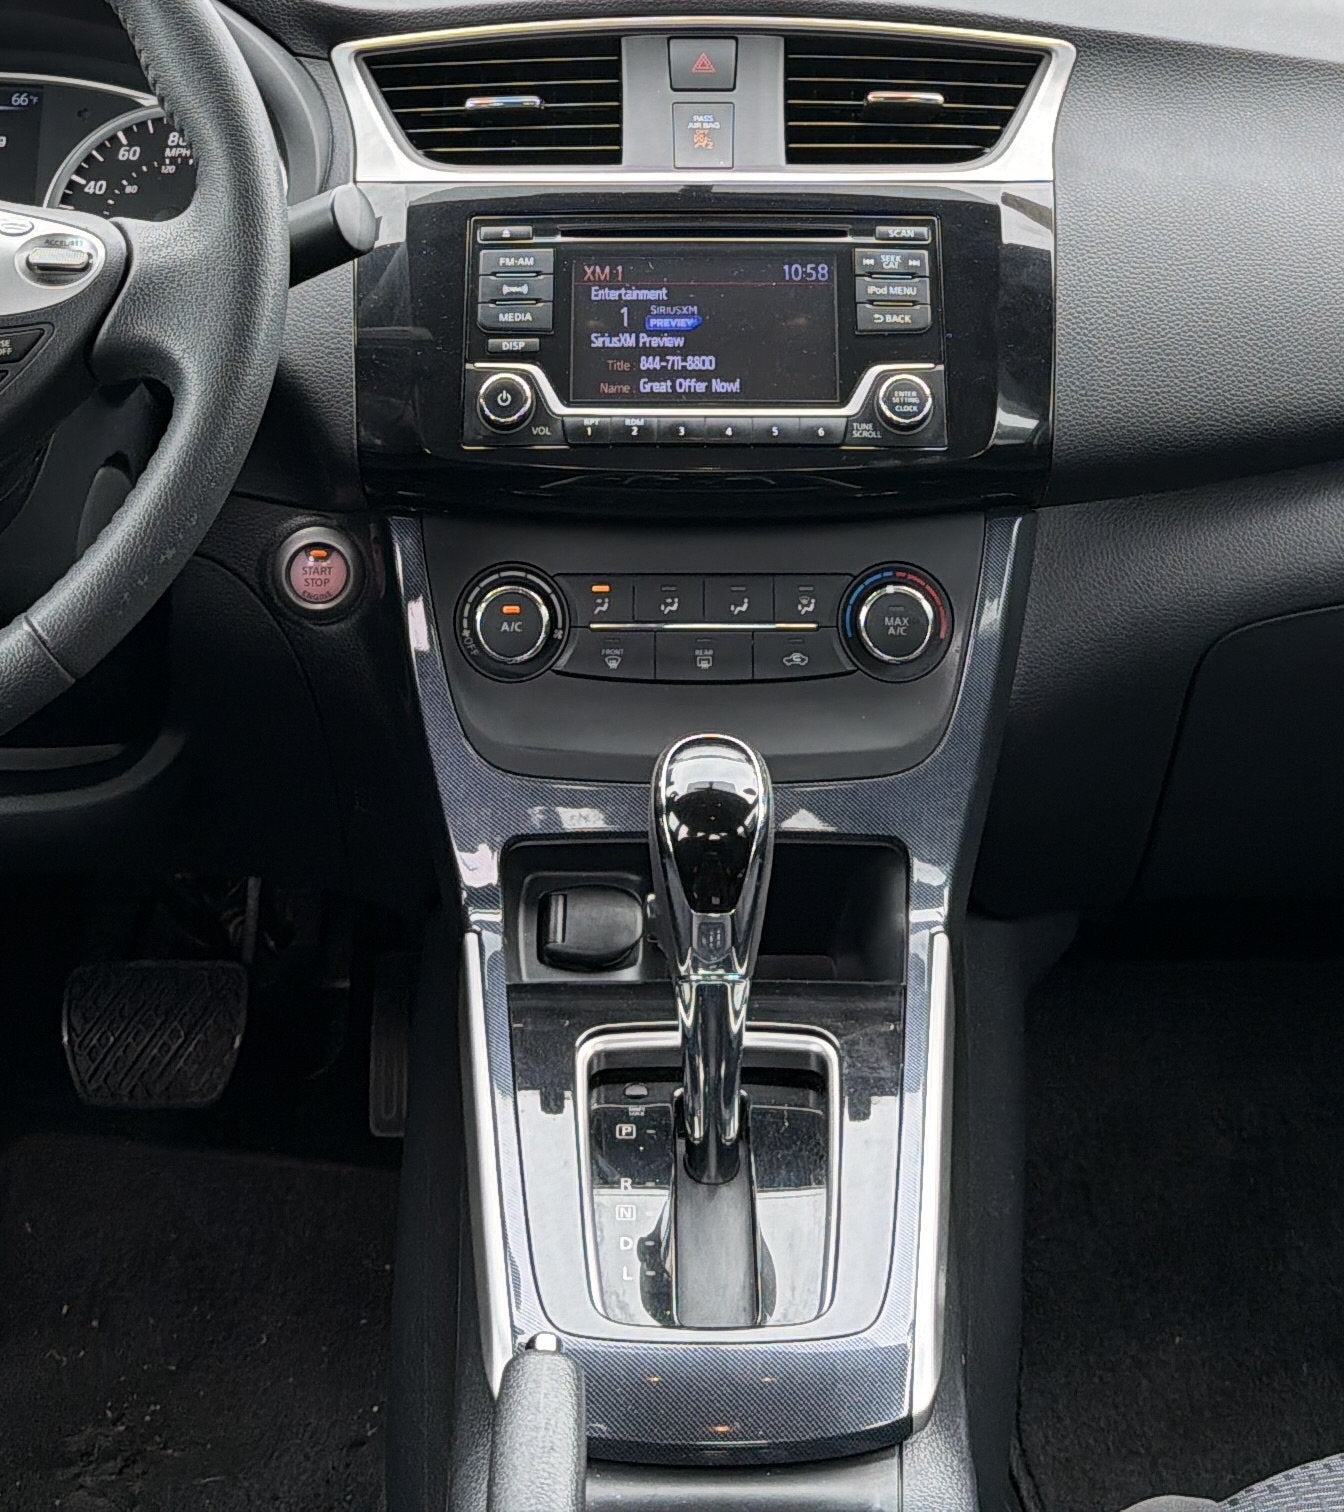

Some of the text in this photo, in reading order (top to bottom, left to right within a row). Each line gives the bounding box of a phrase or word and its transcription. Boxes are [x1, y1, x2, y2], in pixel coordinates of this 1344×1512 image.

[118, 146, 141, 160] 60
[165, 147, 191, 158] MPH
[84, 180, 107, 194] 40
[888, 230, 914, 238] SCAN
[880, 254, 902, 262] SEEK
[584, 266, 610, 281] XM
[783, 264, 829, 282] 10:58
[590, 287, 668, 301] Entertainment
[868, 285, 917, 296] iPod MENU
[498, 313, 532, 322] MEDIA
[620, 307, 629, 327] 1
[885, 314, 912, 324] BACK
[650, 319, 694, 328] PREVIEW
[590, 333, 685, 348] SiriusXM Preview
[502, 342, 526, 351] DISP
[607, 356, 716, 371] Title 844-711-8800
[600, 379, 740, 394] Name Great Offer Now!
[894, 404, 919, 412] CLOCK
[532, 426, 552, 435] VOL
[586, 426, 592, 436] 1
[631, 426, 638, 436] 2
[678, 426, 685, 436] 3
[726, 426, 732, 436] 4
[772, 426, 778, 436] 5
[818, 426, 824, 436] 6
[852, 430, 882, 438] SCROLL
[302, 566, 334, 576] START
[304, 578, 330, 586] STOP
[500, 622, 523, 632] A/C
[884, 617, 910, 627] MAX
[888, 626, 907, 636] A/C
[464, 637, 480, 656] OFF
[621, 1126, 632, 1136] P
[620, 1178, 632, 1192] R
[620, 1208, 632, 1218] N
[620, 1237, 633, 1250] D
[622, 1266, 633, 1280] L
